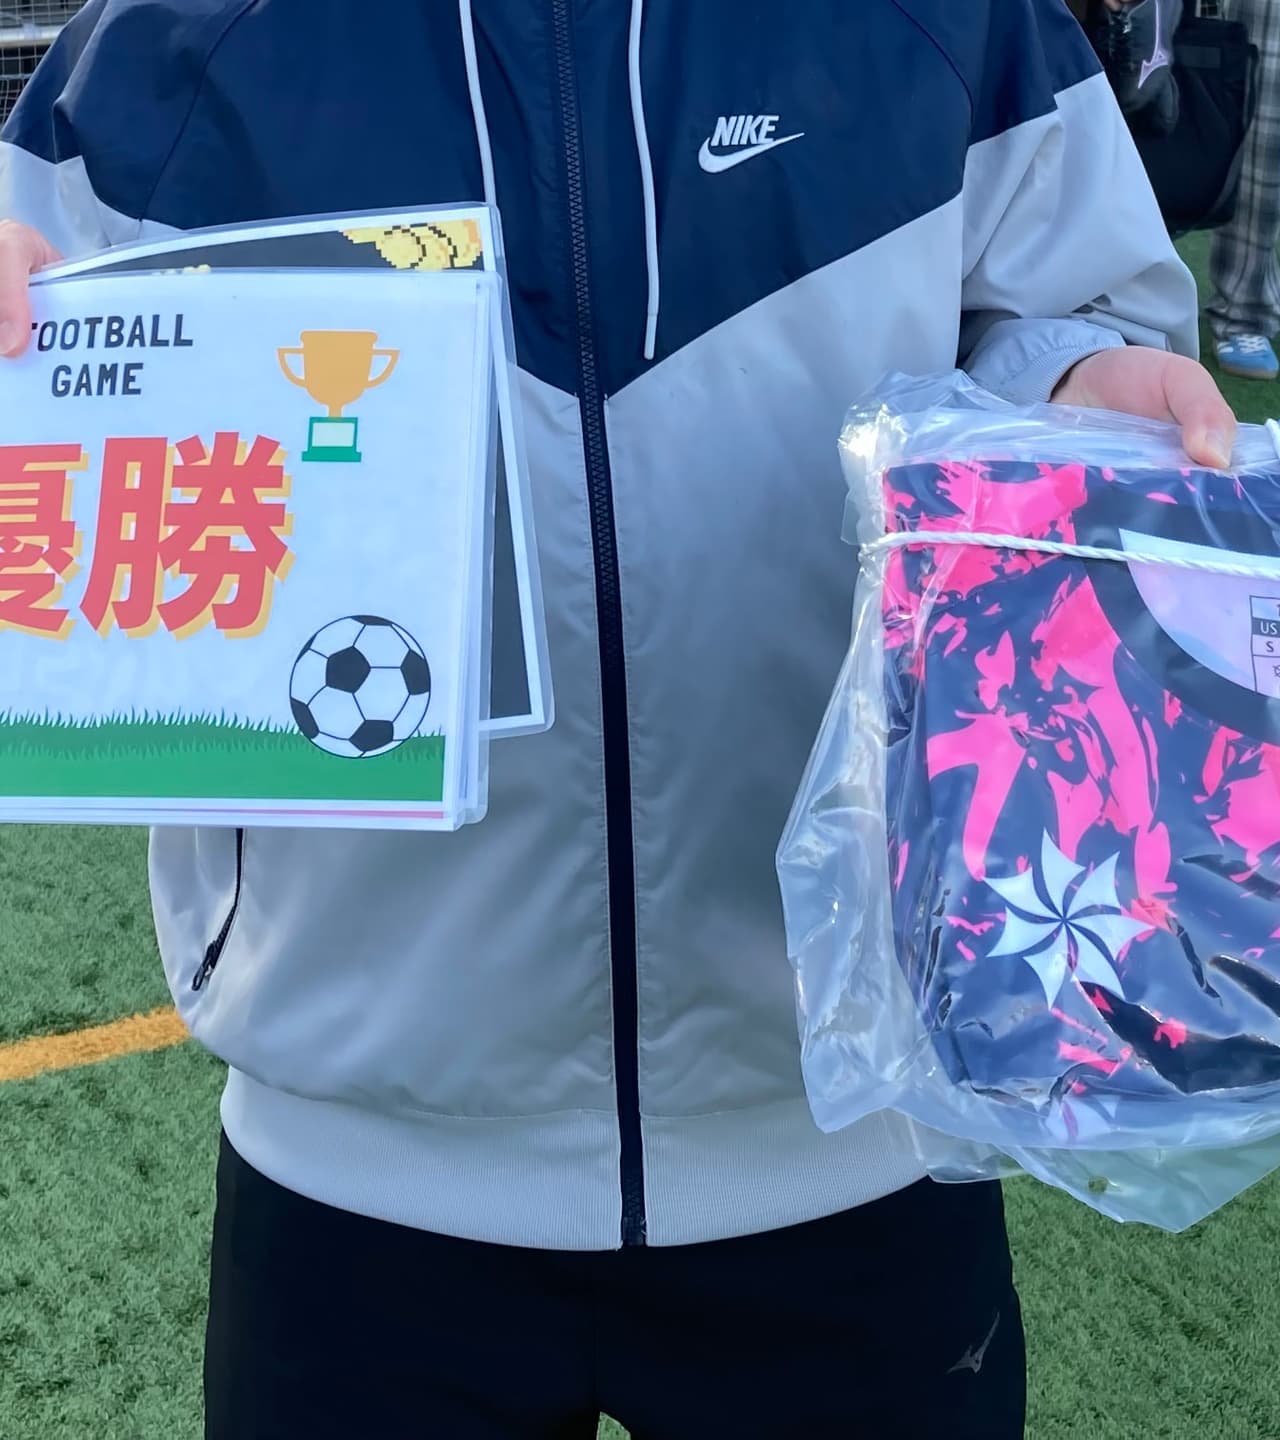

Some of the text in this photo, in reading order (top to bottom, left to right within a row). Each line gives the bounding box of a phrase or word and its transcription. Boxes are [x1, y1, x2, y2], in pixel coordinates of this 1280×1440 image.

[710, 115, 780, 147] NIKE
[31, 313, 194, 352] OOTBALL
[51, 362, 144, 398] GAME
[1260, 621, 1278, 635] US
[1265, 641, 1275, 653] S
